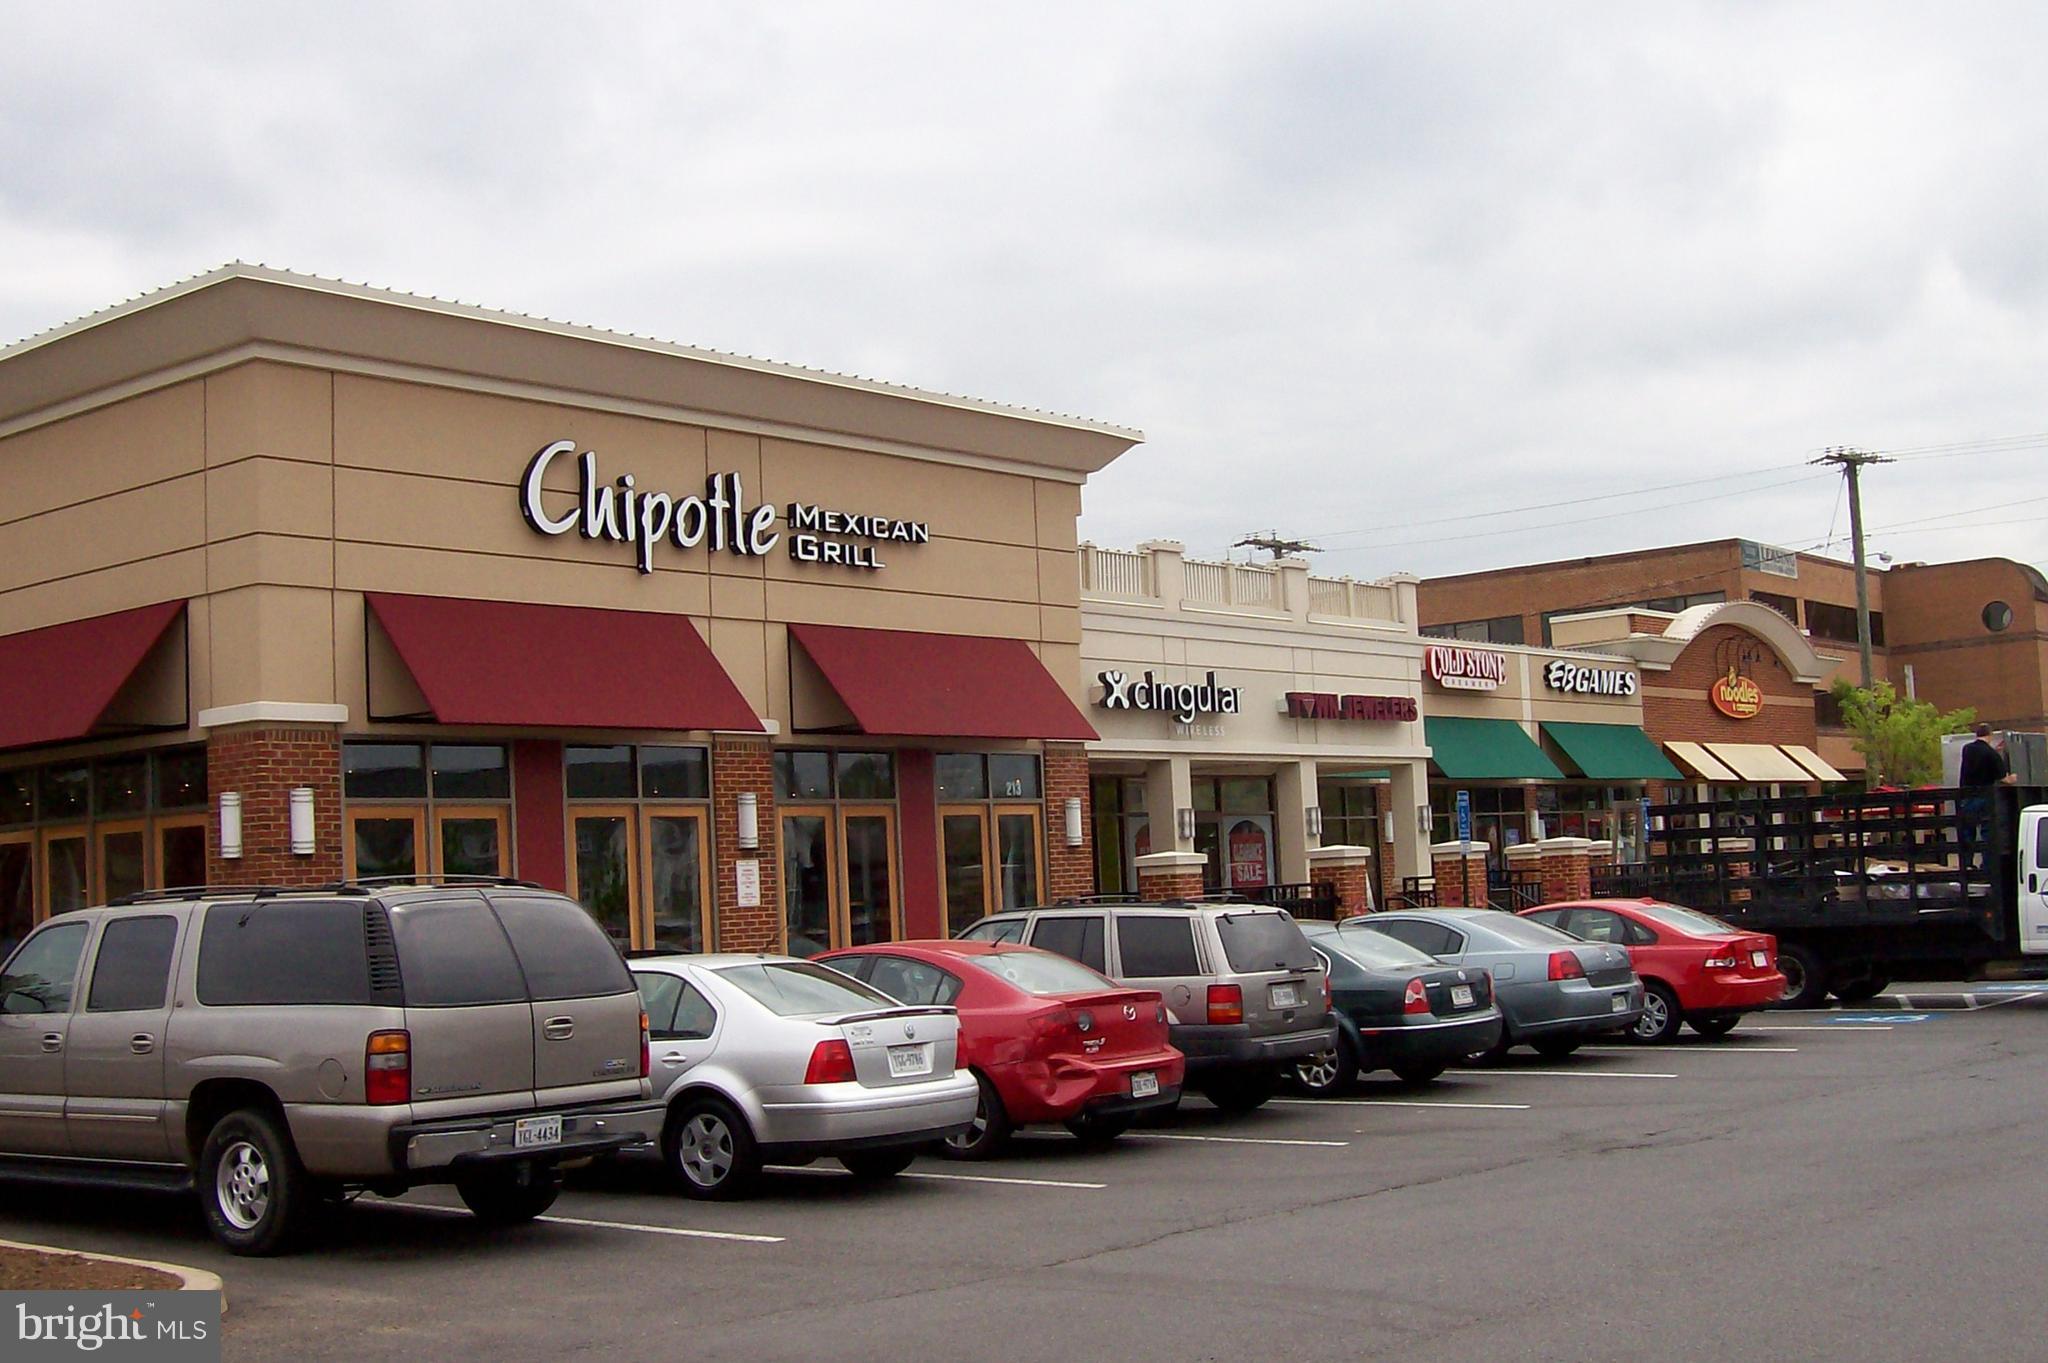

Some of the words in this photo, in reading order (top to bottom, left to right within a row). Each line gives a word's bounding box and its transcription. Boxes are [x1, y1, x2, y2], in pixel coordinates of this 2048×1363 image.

[519, 439, 780, 575] Chipotle
[789, 503, 930, 543] MEXICAN
[790, 535, 886, 569] GRILL
[1430, 646, 1465, 680] COLD
[1466, 649, 1508, 685] STONE
[1546, 660, 1576, 692] EB
[1576, 668, 1636, 695] GAMES
[1131, 670, 1245, 723] cingular
[1340, 694, 1418, 721] JEWELERS
[1720, 680, 1759, 703] noodles
[1175, 724, 1225, 736] WIRELESS
[1005, 781, 1021, 796] 213
[1235, 863, 1264, 882] SALE
